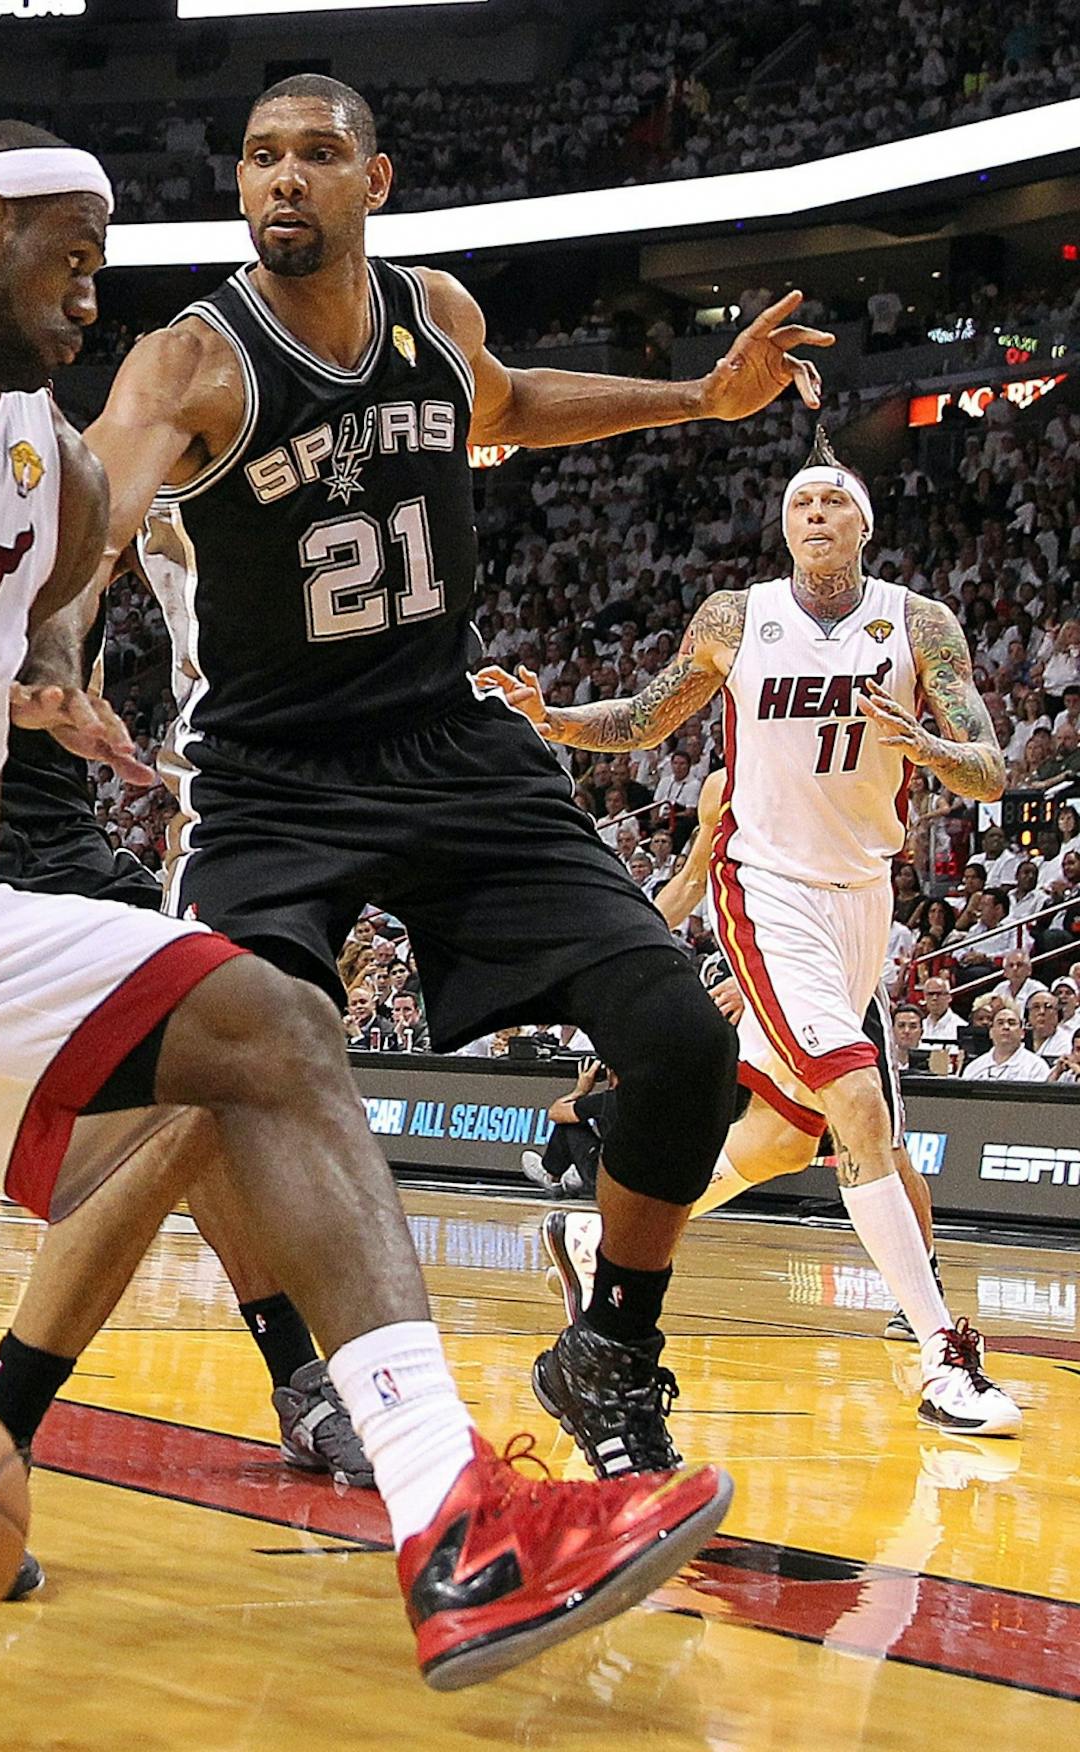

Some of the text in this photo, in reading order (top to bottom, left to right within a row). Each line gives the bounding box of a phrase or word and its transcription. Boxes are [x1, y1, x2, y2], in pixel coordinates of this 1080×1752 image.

[244, 400, 455, 504] SPURS
[299, 496, 446, 642] 21
[758, 658, 892, 720] HEAT
[815, 722, 866, 774] 11
[362, 1098, 407, 1135] CAR
[409, 1101, 446, 1138] ALL
[448, 1104, 534, 1145] SEASON
